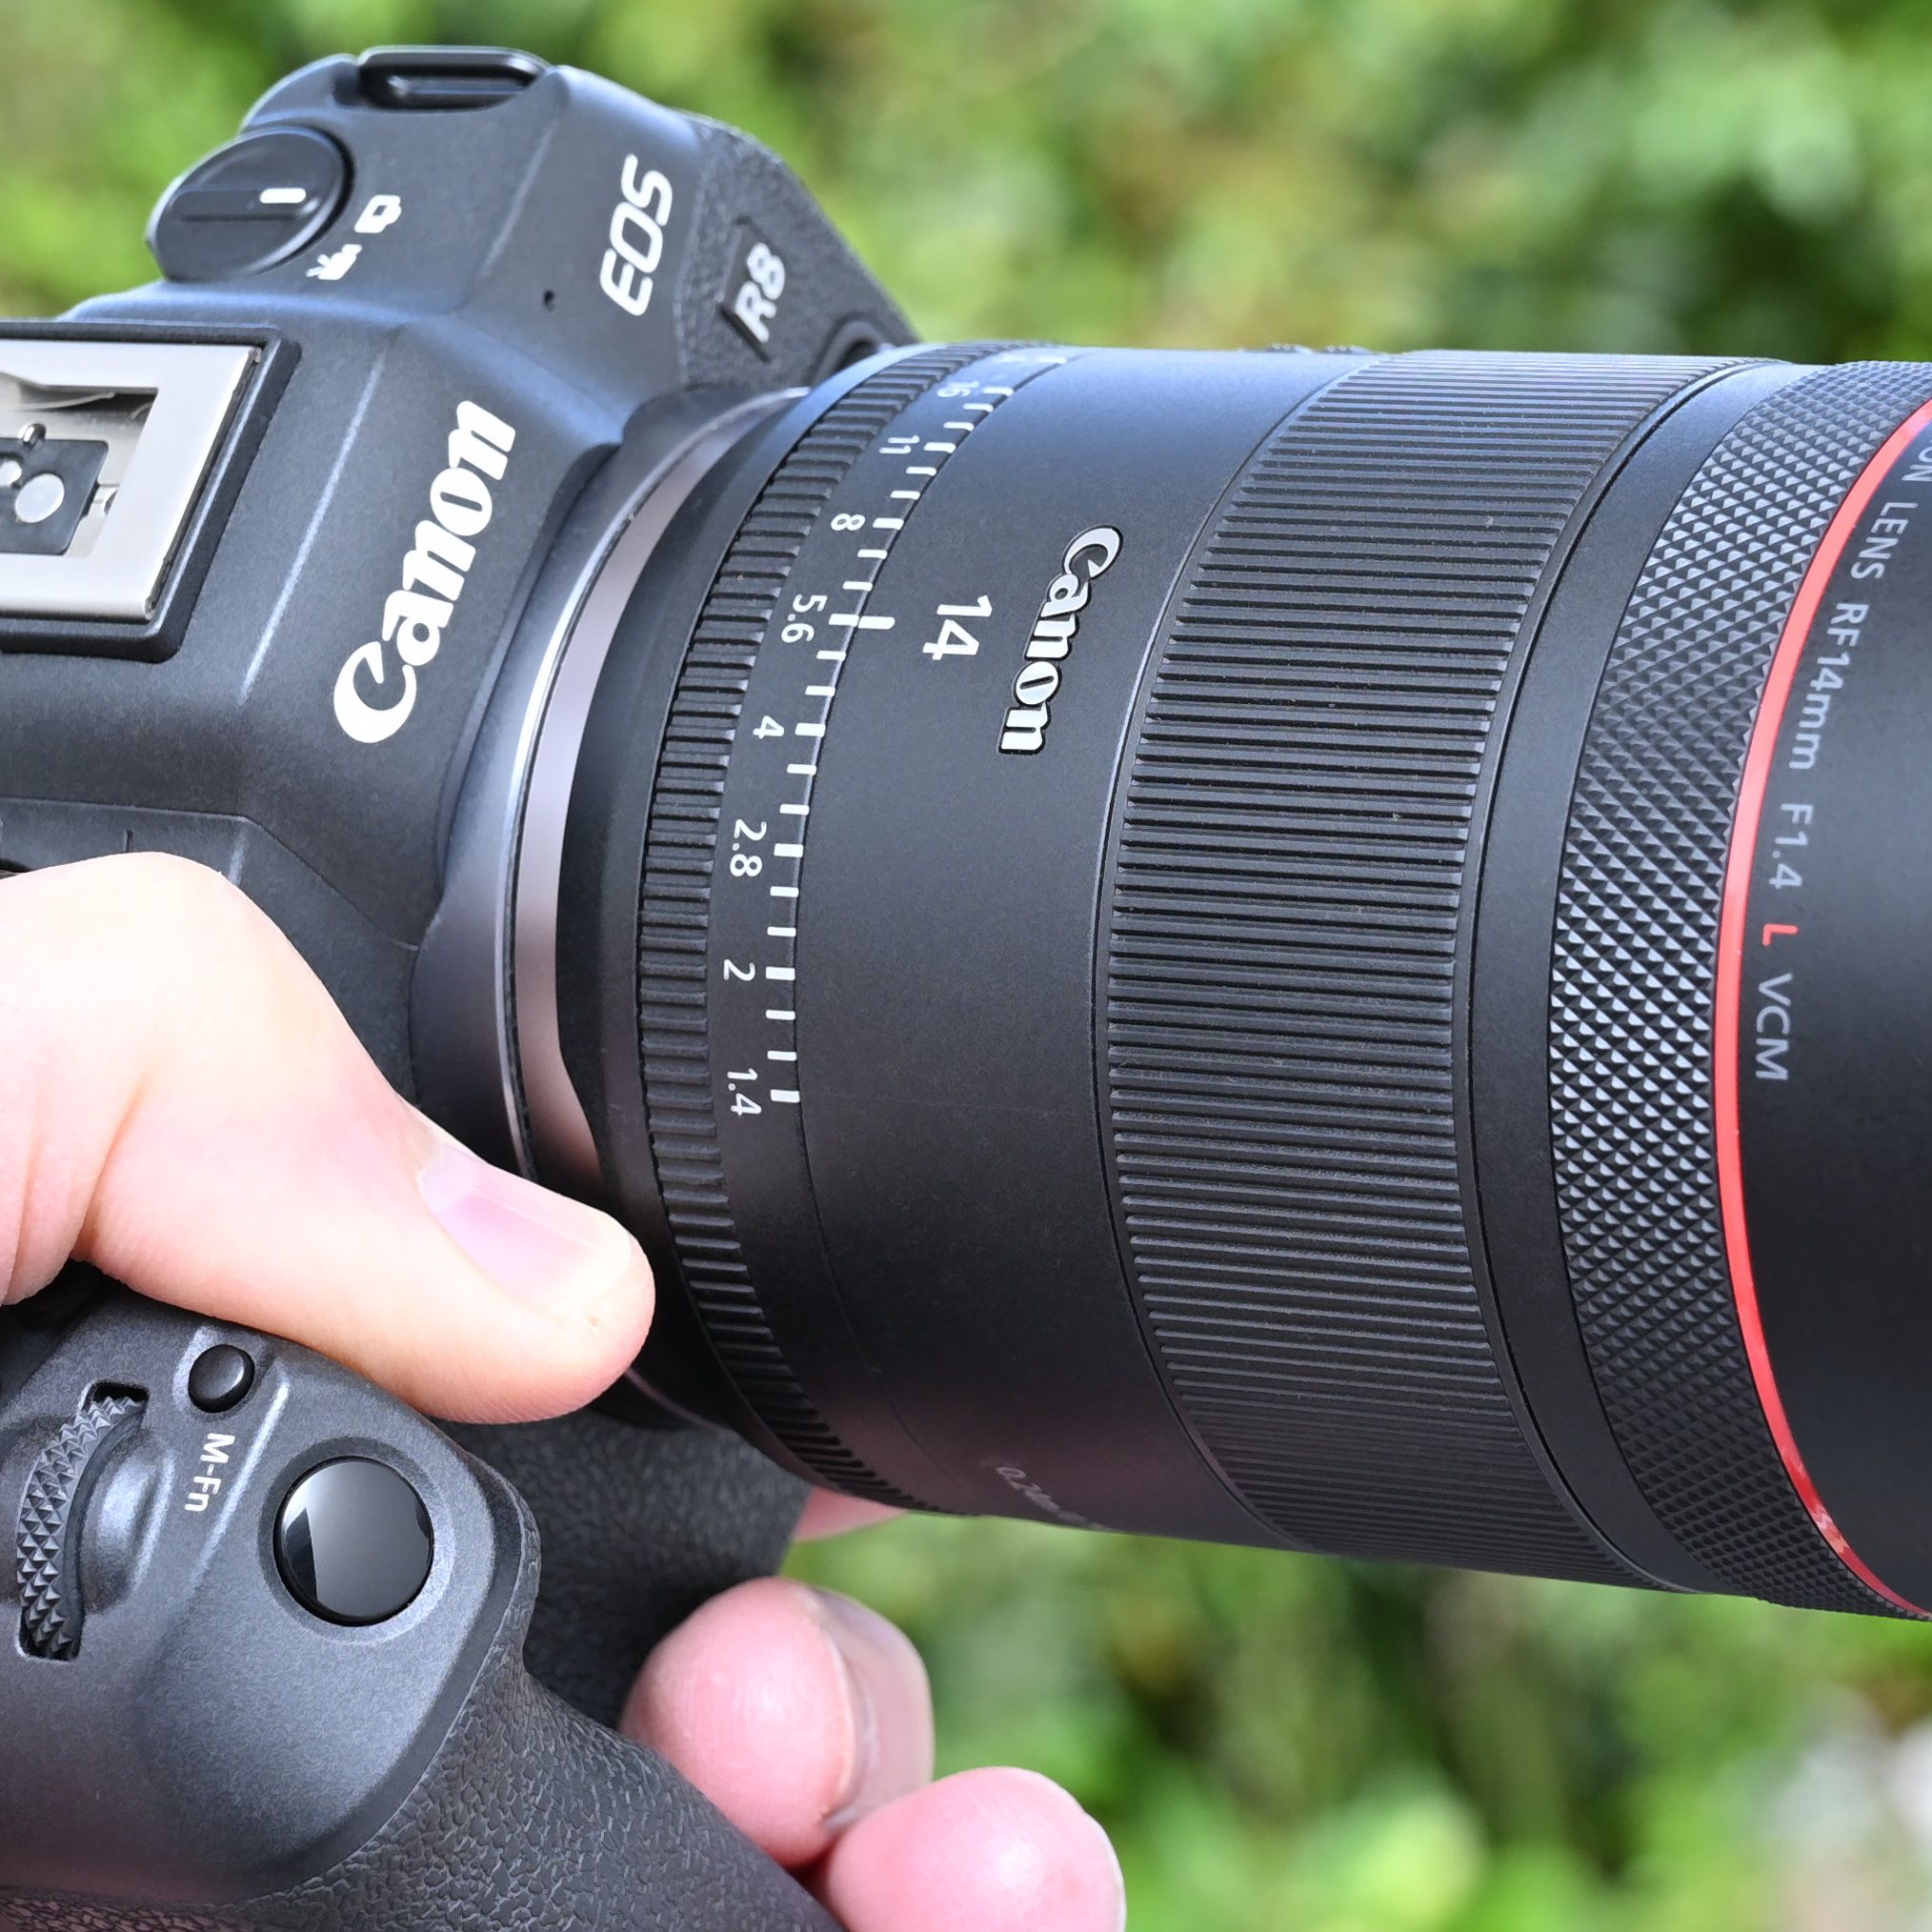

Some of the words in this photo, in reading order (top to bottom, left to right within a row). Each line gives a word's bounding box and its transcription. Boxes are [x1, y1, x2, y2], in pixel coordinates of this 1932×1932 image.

[600, 153, 673, 316] EOS
[735, 242, 785, 343] R8
[878, 434, 920, 453] 11
[831, 513, 866, 532] 8
[1850, 501, 1919, 579] LENS
[333, 400, 515, 743] Canon
[781, 594, 828, 643] 5.6
[922, 594, 993, 661] 14
[997, 526, 1122, 755] Canon
[1788, 603, 1870, 770] RF14mm
[752, 714, 785, 739] 4
[729, 818, 767, 877] 2.8
[1768, 803, 1814, 890] F1.4
[723, 958, 756, 981] 2
[1762, 923, 1799, 946] L
[1755, 973, 1794, 1081] VCM
[727, 1067, 762, 1117] 1.4
[184, 1432, 235, 1512] M-Fn
